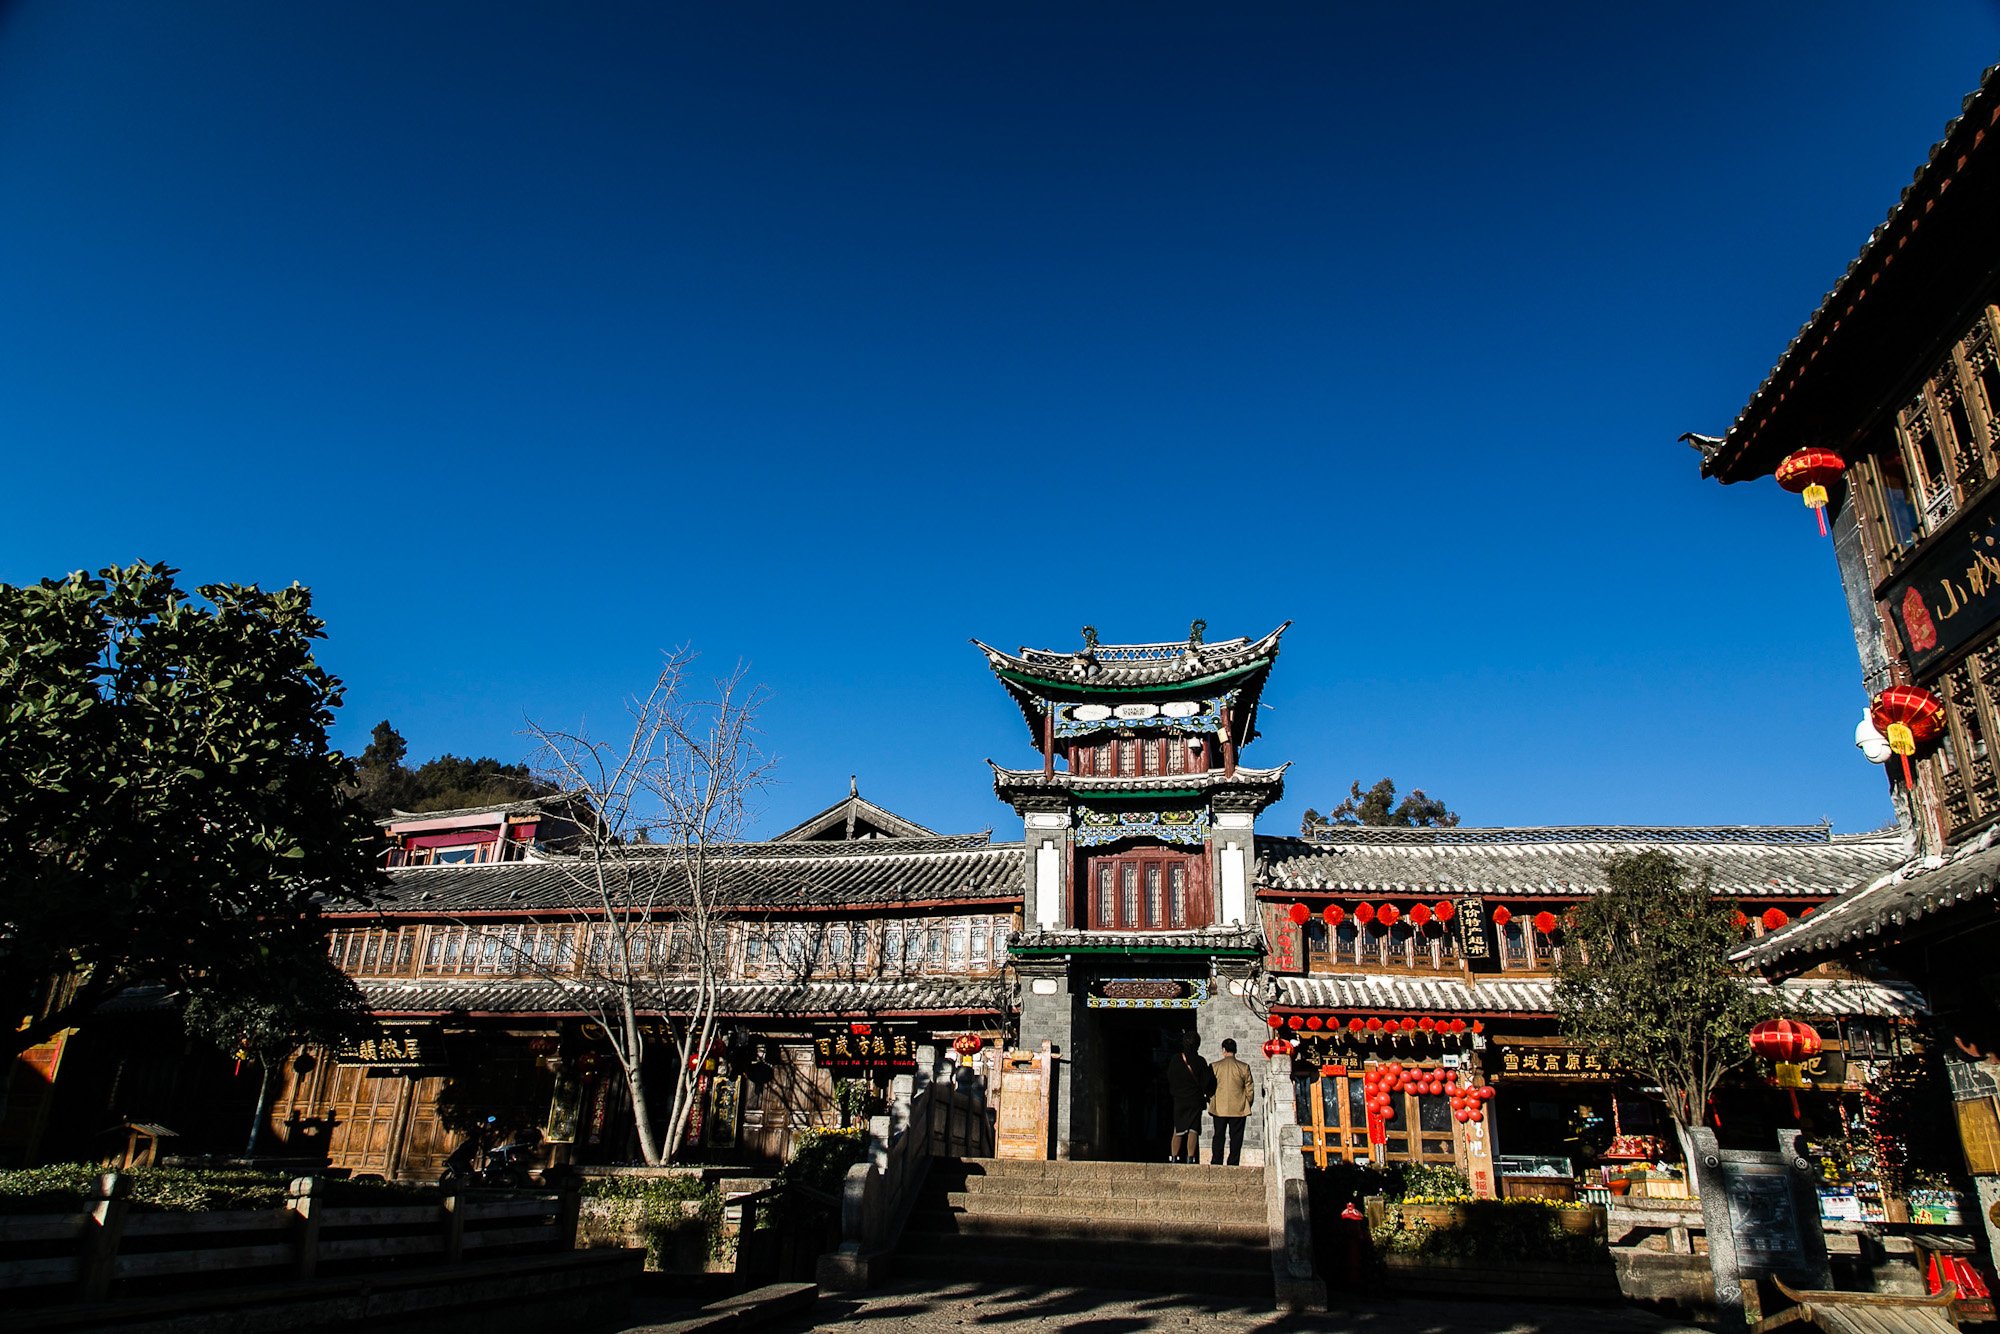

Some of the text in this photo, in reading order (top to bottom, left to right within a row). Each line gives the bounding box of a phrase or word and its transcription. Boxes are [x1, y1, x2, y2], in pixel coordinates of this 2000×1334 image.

[1462, 900, 1485, 954] 平价特产超市
